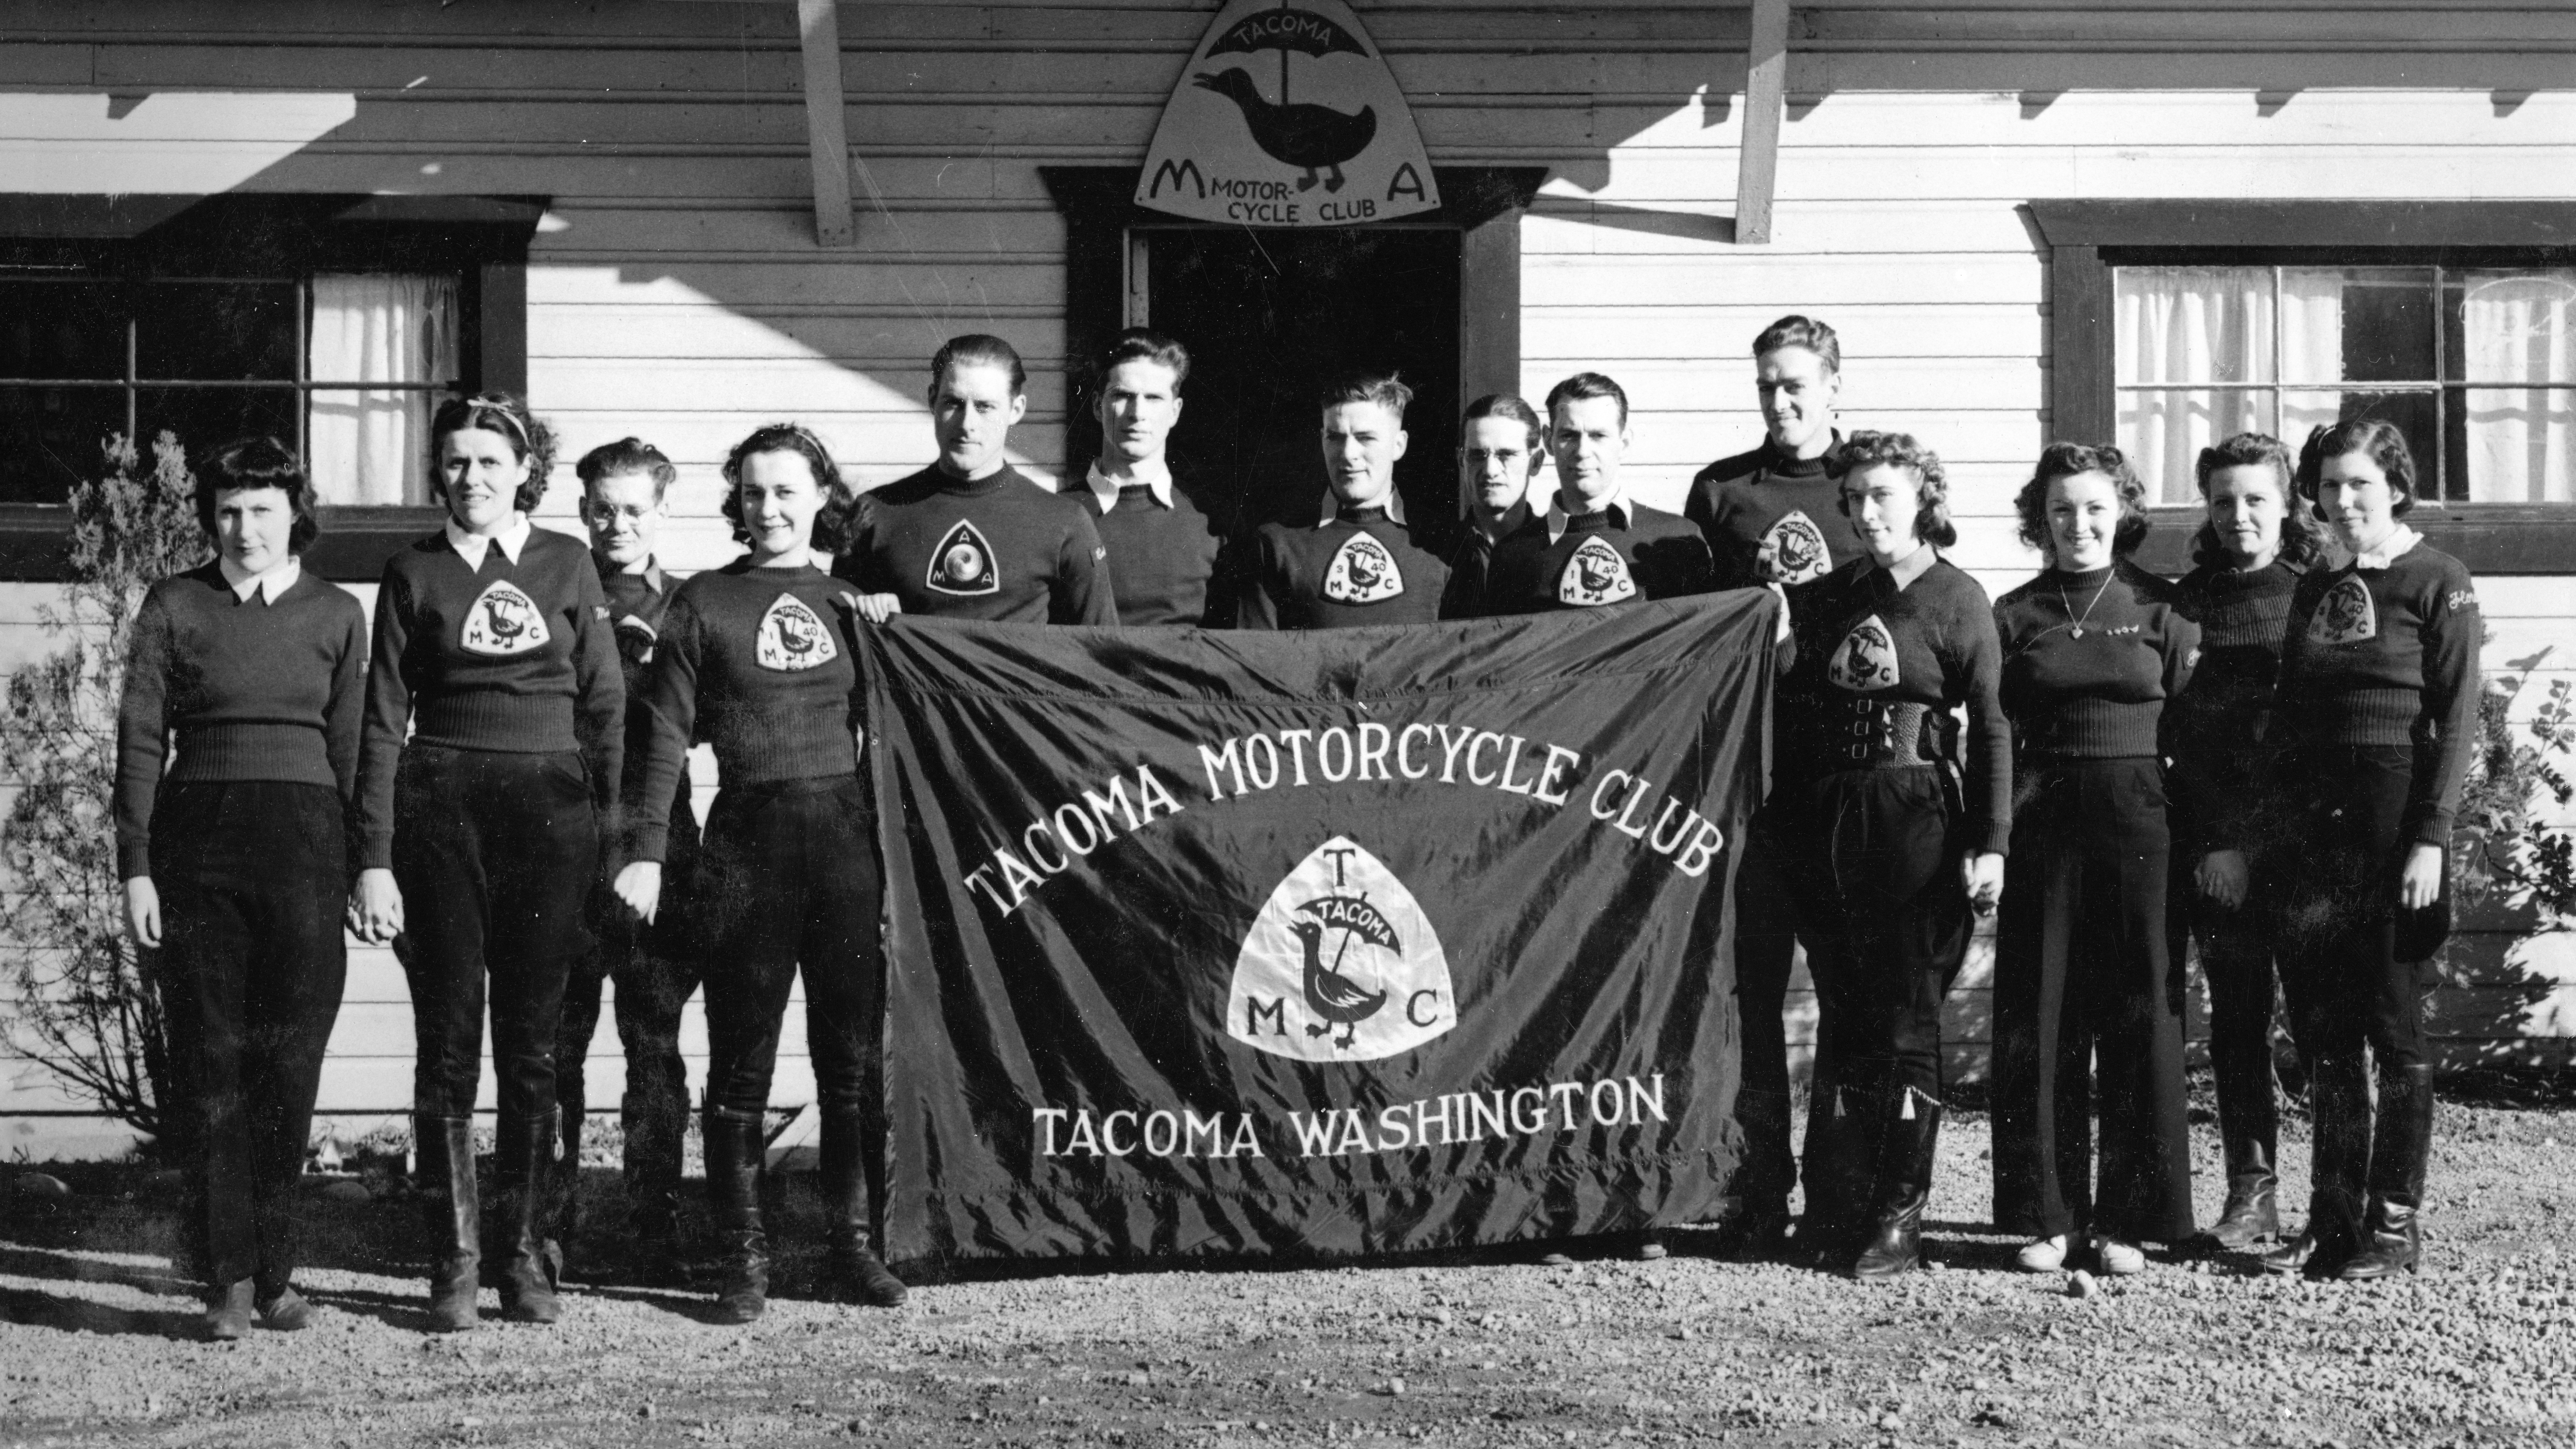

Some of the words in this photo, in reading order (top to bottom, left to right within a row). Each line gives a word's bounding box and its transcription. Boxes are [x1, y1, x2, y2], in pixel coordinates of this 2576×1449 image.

[1233, 15, 1332, 45] TACOMA
[1150, 159, 1206, 199] M
[1387, 162, 1425, 201] A
[1212, 178, 1294, 200] MOTOR-
[1228, 202, 1299, 223] CYCLE
[1319, 199, 1376, 221] CLUB
[959, 531, 970, 542] A
[1353, 544, 1383, 559] TACOMA
[1584, 548, 1615, 560] TACOMA
[1371, 563, 1386, 571] 40
[1603, 565, 1619, 574] 40
[1814, 562, 1824, 576] C
[933, 570, 945, 582] M
[981, 572, 993, 583] A
[1330, 580, 1342, 593] M
[1384, 578, 1394, 590] C
[1563, 587, 1575, 600] M
[1617, 580, 1628, 592] C
[492, 592, 526, 608] TACOMA
[779, 607, 813, 623] TACOMA
[470, 630, 482, 643] M
[530, 627, 539, 639] C
[803, 627, 818, 636] 40
[2357, 620, 2368, 634] C
[764, 648, 777, 661] M
[820, 642, 829, 654] C
[1830, 666, 1842, 680] M
[1880, 667, 1891, 682] C
[964, 765, 1184, 917] TACOMA
[1197, 723, 1580, 806] MOTORCYCLE
[1590, 768, 1724, 878] CLUB
[1323, 848, 1356, 886] T
[1317, 900, 1392, 945] TACOMA
[1246, 996, 1289, 1036] M
[1406, 988, 1438, 1027] C
[1033, 1106, 1265, 1159] TACOMA
[1289, 1073, 1668, 1156] WASHINGTON
